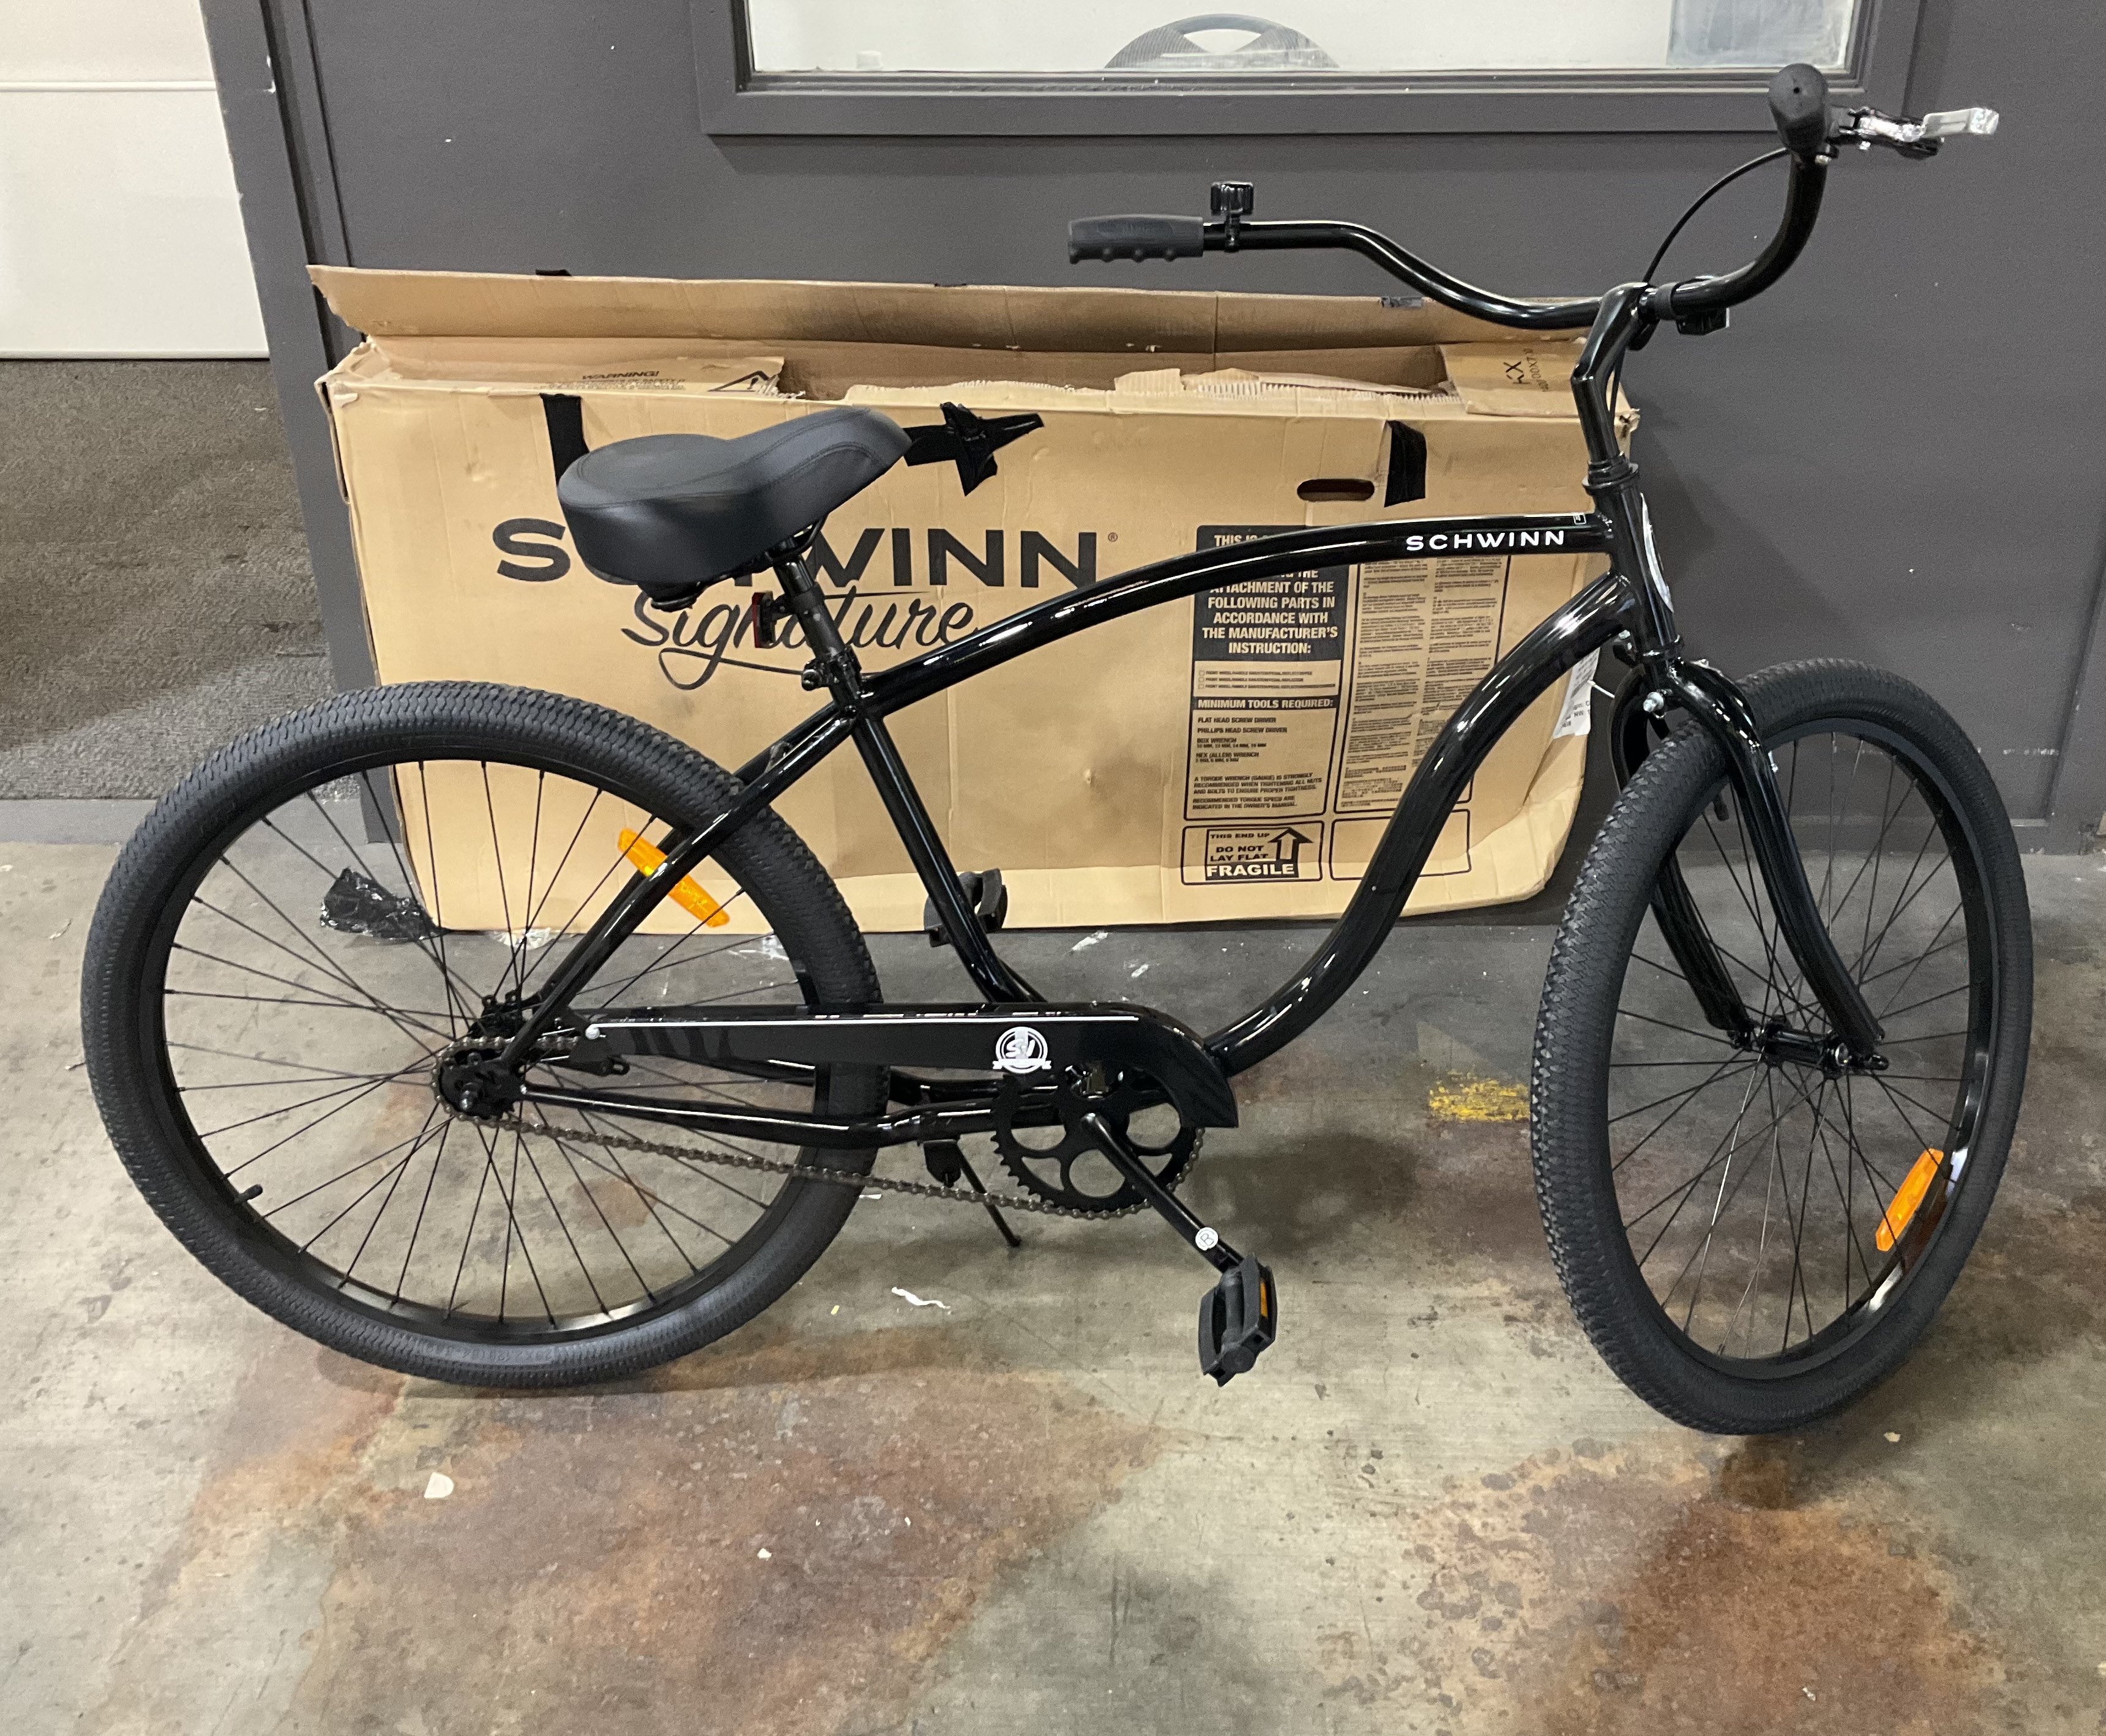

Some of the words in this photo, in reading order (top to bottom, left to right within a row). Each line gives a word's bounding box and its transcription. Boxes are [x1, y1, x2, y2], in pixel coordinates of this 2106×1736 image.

[583, 371, 659, 379] WARNING!
[1406, 530, 1564, 551] SCHWINN
[1294, 581, 1309, 593] OF
[1312, 581, 1334, 593] THE
[1208, 597, 1278, 609] FOLLOWING
[1281, 597, 1319, 609] PARTS
[1323, 596, 1335, 608] IN
[1213, 612, 1295, 624] ACCORDANCE
[1298, 612, 1328, 624] WITH
[1202, 627, 1225, 638] THE
[1228, 626, 1338, 639] MANUFACTURER'S
[1228, 642, 1311, 654] INSTRUCTION:
[1198, 699, 1245, 709] MINIMUM
[1248, 699, 1279, 709] TOOLS
[1282, 698, 1333, 709] REQUIRED:
[1206, 863, 1294, 877] FRAGILE
